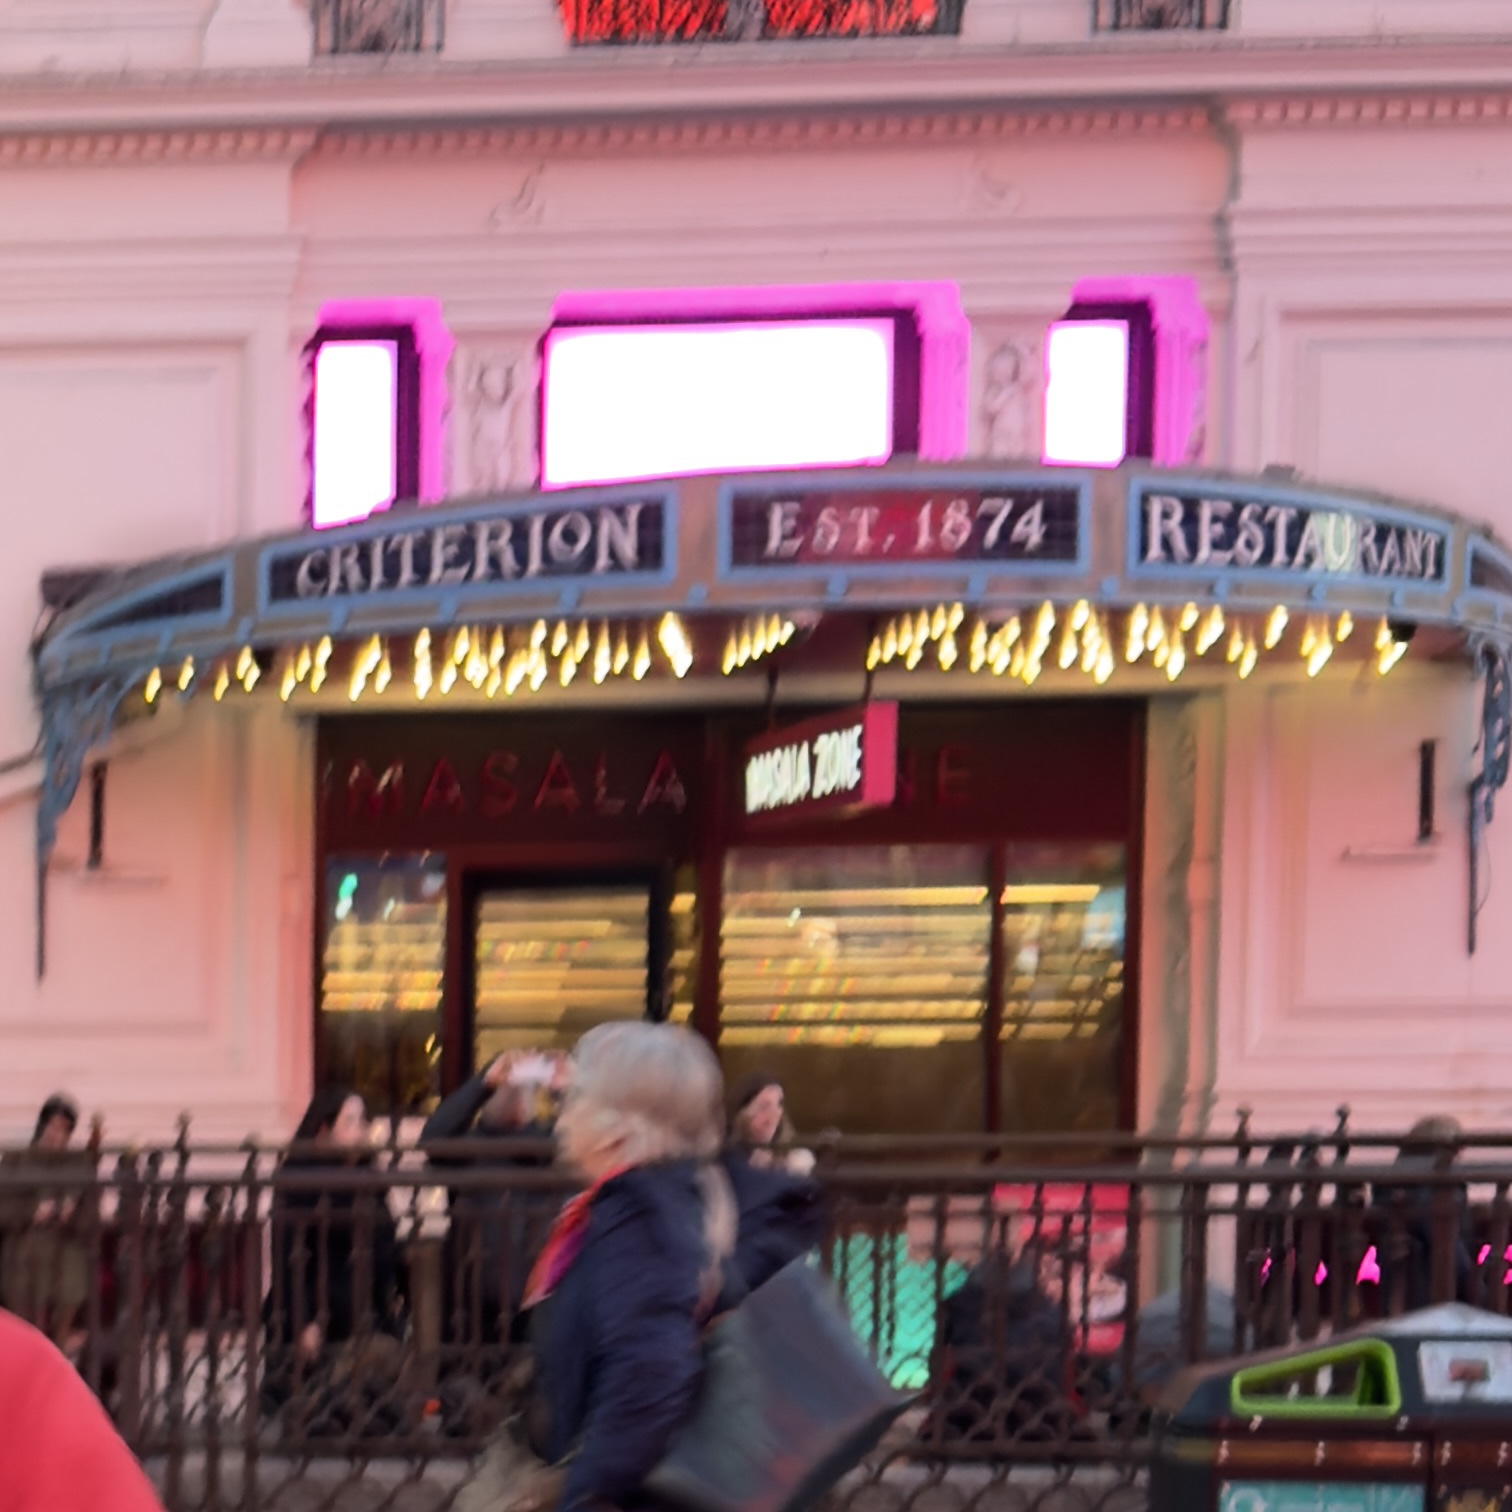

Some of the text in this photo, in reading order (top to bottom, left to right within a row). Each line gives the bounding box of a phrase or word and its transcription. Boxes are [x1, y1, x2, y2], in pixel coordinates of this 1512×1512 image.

[295, 495, 1440, 597] CRITERION EST. 1874 RESTAURANT
[344, 746, 687, 818] MASALA
[812, 724, 863, 799] ZONE
